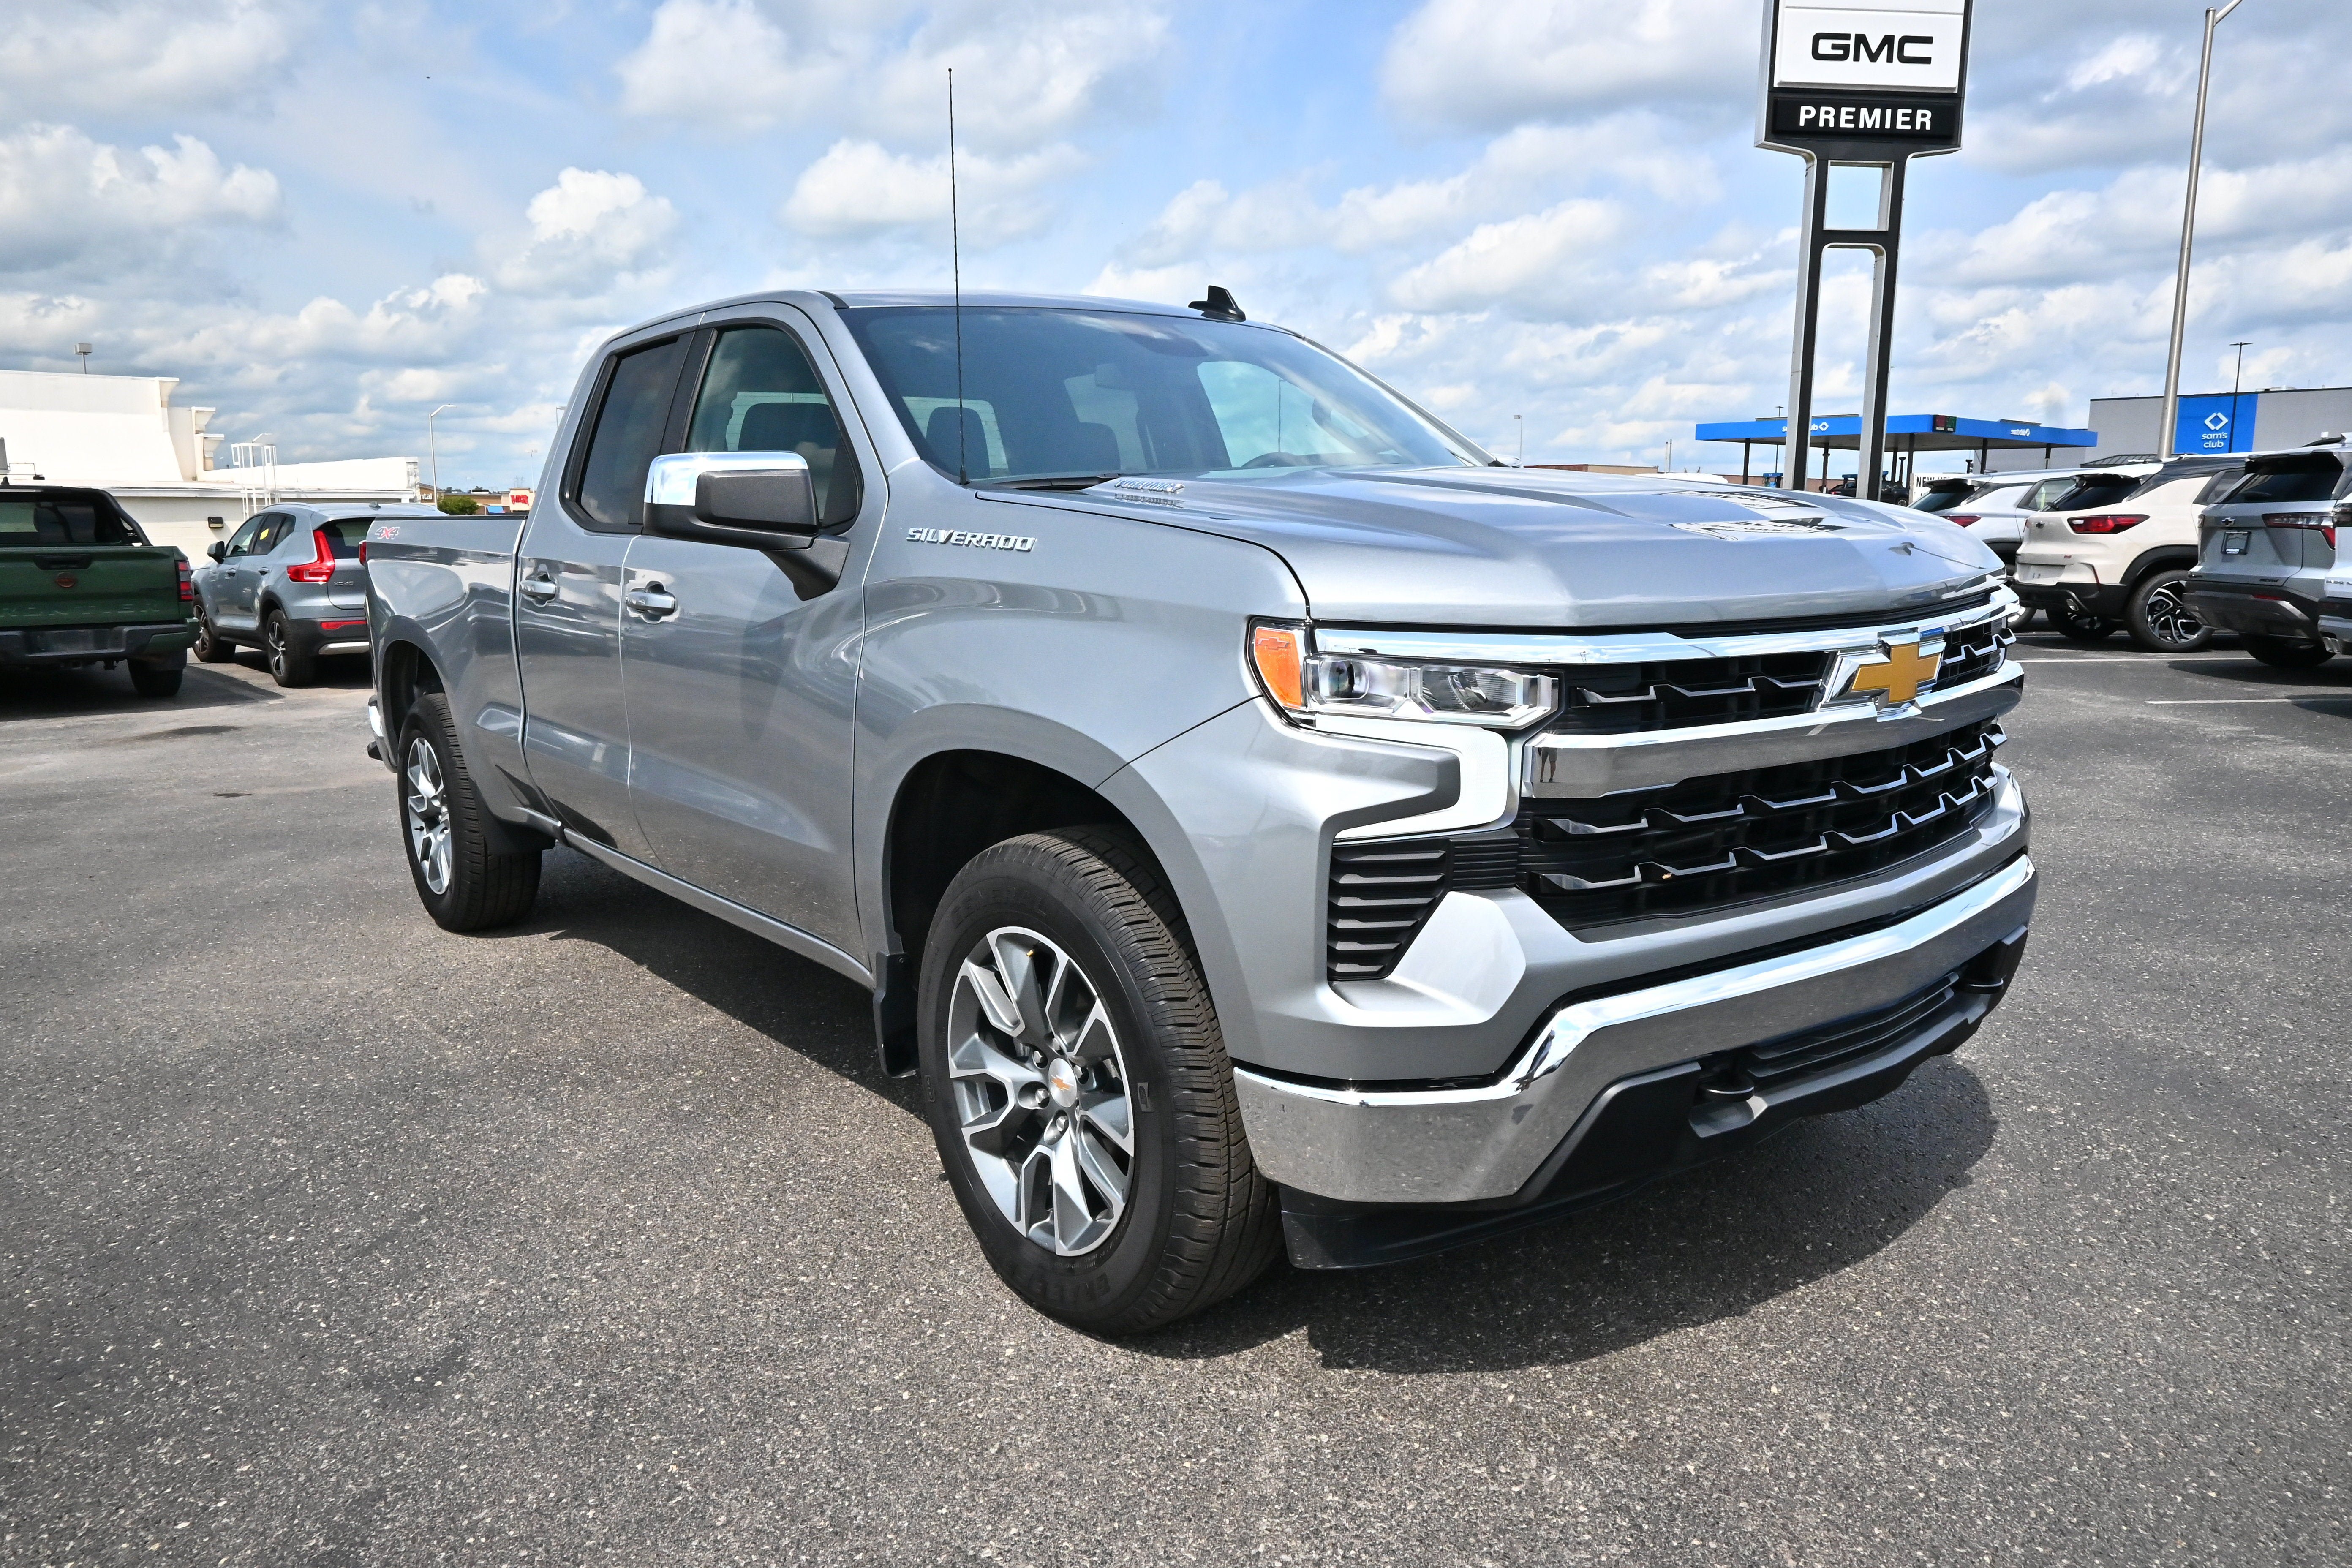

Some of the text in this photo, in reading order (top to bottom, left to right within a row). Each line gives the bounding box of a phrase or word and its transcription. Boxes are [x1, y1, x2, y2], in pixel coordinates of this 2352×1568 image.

[1811, 32, 1933, 64] GMC
[1799, 106, 1932, 131] PREMIER
[2201, 432, 2228, 440] sam's
[2203, 440, 2224, 448] club
[906, 528, 1036, 552] SILVERADO
